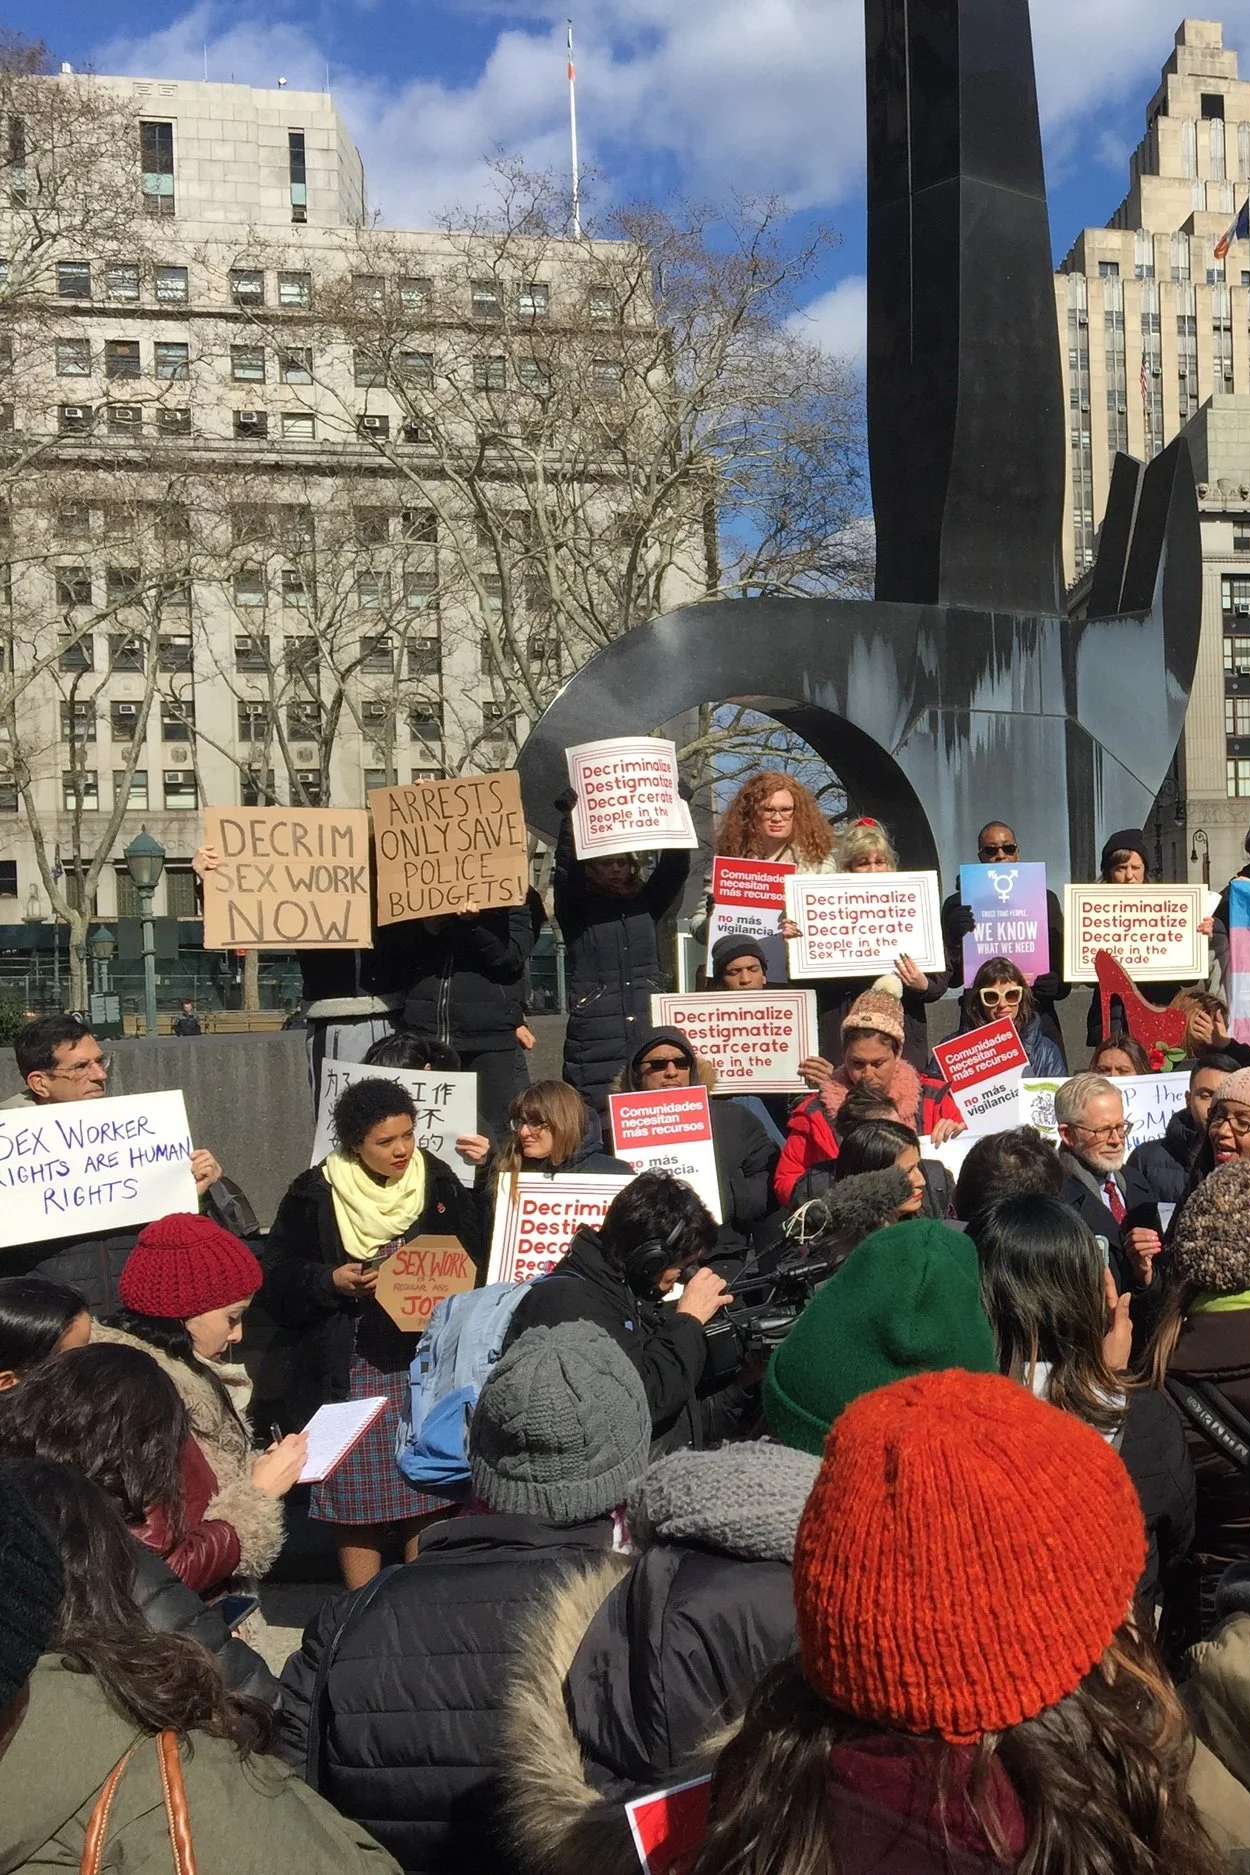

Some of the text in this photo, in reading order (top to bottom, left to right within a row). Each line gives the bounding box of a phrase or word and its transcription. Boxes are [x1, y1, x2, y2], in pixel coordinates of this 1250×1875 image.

[582, 758, 671, 779] Decriminalize
[584, 775, 673, 795] Destigmatize
[388, 780, 503, 826] ARRESTS
[587, 791, 673, 810] Decarcerate
[638, 807, 650, 818] in
[590, 816, 660, 834] Sex Trade
[219, 818, 354, 859] DECRIM
[380, 811, 522, 861] ONLY SAVE
[215, 863, 368, 894] SEX WORK
[404, 853, 494, 888] POLICE
[721, 869, 785, 883] Comunidade
[720, 879, 769, 891] necesitan
[720, 888, 742, 897] más
[389, 876, 524, 917] BUDGETS!
[805, 891, 916, 905] Decriminalize
[807, 905, 916, 924] Destigmatize
[1082, 900, 1188, 913] Decriminalize
[228, 900, 351, 941] NOW
[737, 916, 762, 925] más
[808, 921, 913, 936] Decarcerate
[1082, 915, 1187, 932] Destigmatize
[974, 921, 1038, 941] WE KNOW
[1082, 930, 1183, 942] Decarcerate
[809, 937, 899, 951] People in the
[977, 941, 1035, 954] WHAT WE NEED
[1082, 945, 1168, 955] Peple in the
[809, 948, 881, 960] Sex Trade
[674, 1006, 793, 1024] Decriminalize
[692, 1039, 789, 1055] ecarcerate
[945, 1031, 1013, 1064] Comunidades
[731, 1056, 742, 1067] in
[749, 1056, 772, 1067] the
[949, 1048, 997, 1073] necesitan
[953, 1048, 1019, 1081] más recursos
[964, 1084, 1006, 1107] no más
[620, 1101, 703, 1118] Comunidades
[622, 1114, 680, 1128] necesitan
[622, 1121, 705, 1138] más recursos
[55, 1116, 156, 1149] WORKER
[84, 1151, 119, 1174] ARE
[129, 1136, 192, 1168] HUMAN
[649, 1155, 679, 1167] más
[43, 1178, 139, 1214] RIGHTS
[392, 1250, 468, 1278] SEX WORK
